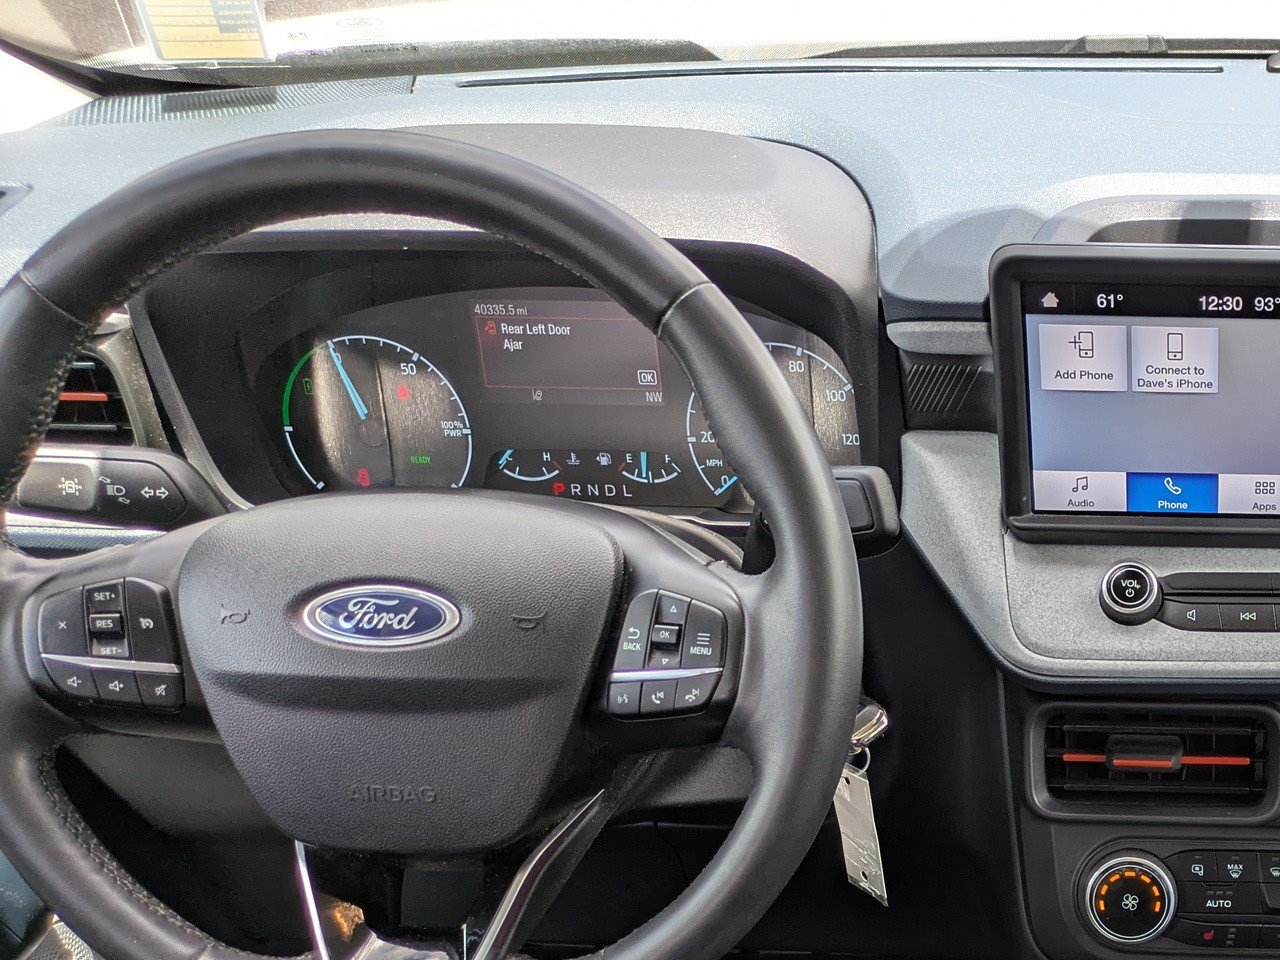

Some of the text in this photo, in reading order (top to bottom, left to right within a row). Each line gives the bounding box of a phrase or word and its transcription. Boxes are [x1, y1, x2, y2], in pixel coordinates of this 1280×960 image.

[1096, 293, 1124, 308] 61°
[1199, 296, 1243, 311] 12:30
[1254, 297, 1280, 311] 93°
[474, 303, 528, 316] 40335.5 mi
[501, 323, 571, 336] Rear Left Door
[503, 338, 523, 352] Ajar
[400, 363, 417, 375] 50
[788, 360, 804, 373] 80
[1145, 364, 1205, 376] Connect to
[641, 372, 654, 383] OK
[1055, 370, 1114, 381] Add Phone
[1137, 378, 1213, 389] Dave's iPhone
[646, 391, 663, 403] NW
[826, 389, 846, 402] 100
[440, 421, 463, 429] 100%
[444, 429, 462, 437] PWR
[842, 433, 860, 446] 120
[410, 456, 431, 464] READY
[543, 452, 550, 462] H
[626, 453, 633, 462] E
[706, 459, 723, 467] MPH
[571, 484, 581, 496] R
[587, 484, 599, 496] N
[604, 484, 616, 497] D
[623, 484, 633, 497] L
[1067, 499, 1095, 508] Audio
[1157, 500, 1188, 510] Phone
[1252, 502, 1277, 512] Apps
[1120, 579, 1138, 588] VOL
[338, 597, 418, 630] Ford
[96, 620, 113, 629] RES
[660, 631, 670, 639] OK
[623, 642, 642, 651] BACK
[690, 646, 712, 656] MENU
[350, 784, 437, 803] AIRBAG
[1227, 863, 1243, 871] MAX
[1206, 900, 1232, 908] AUTO
